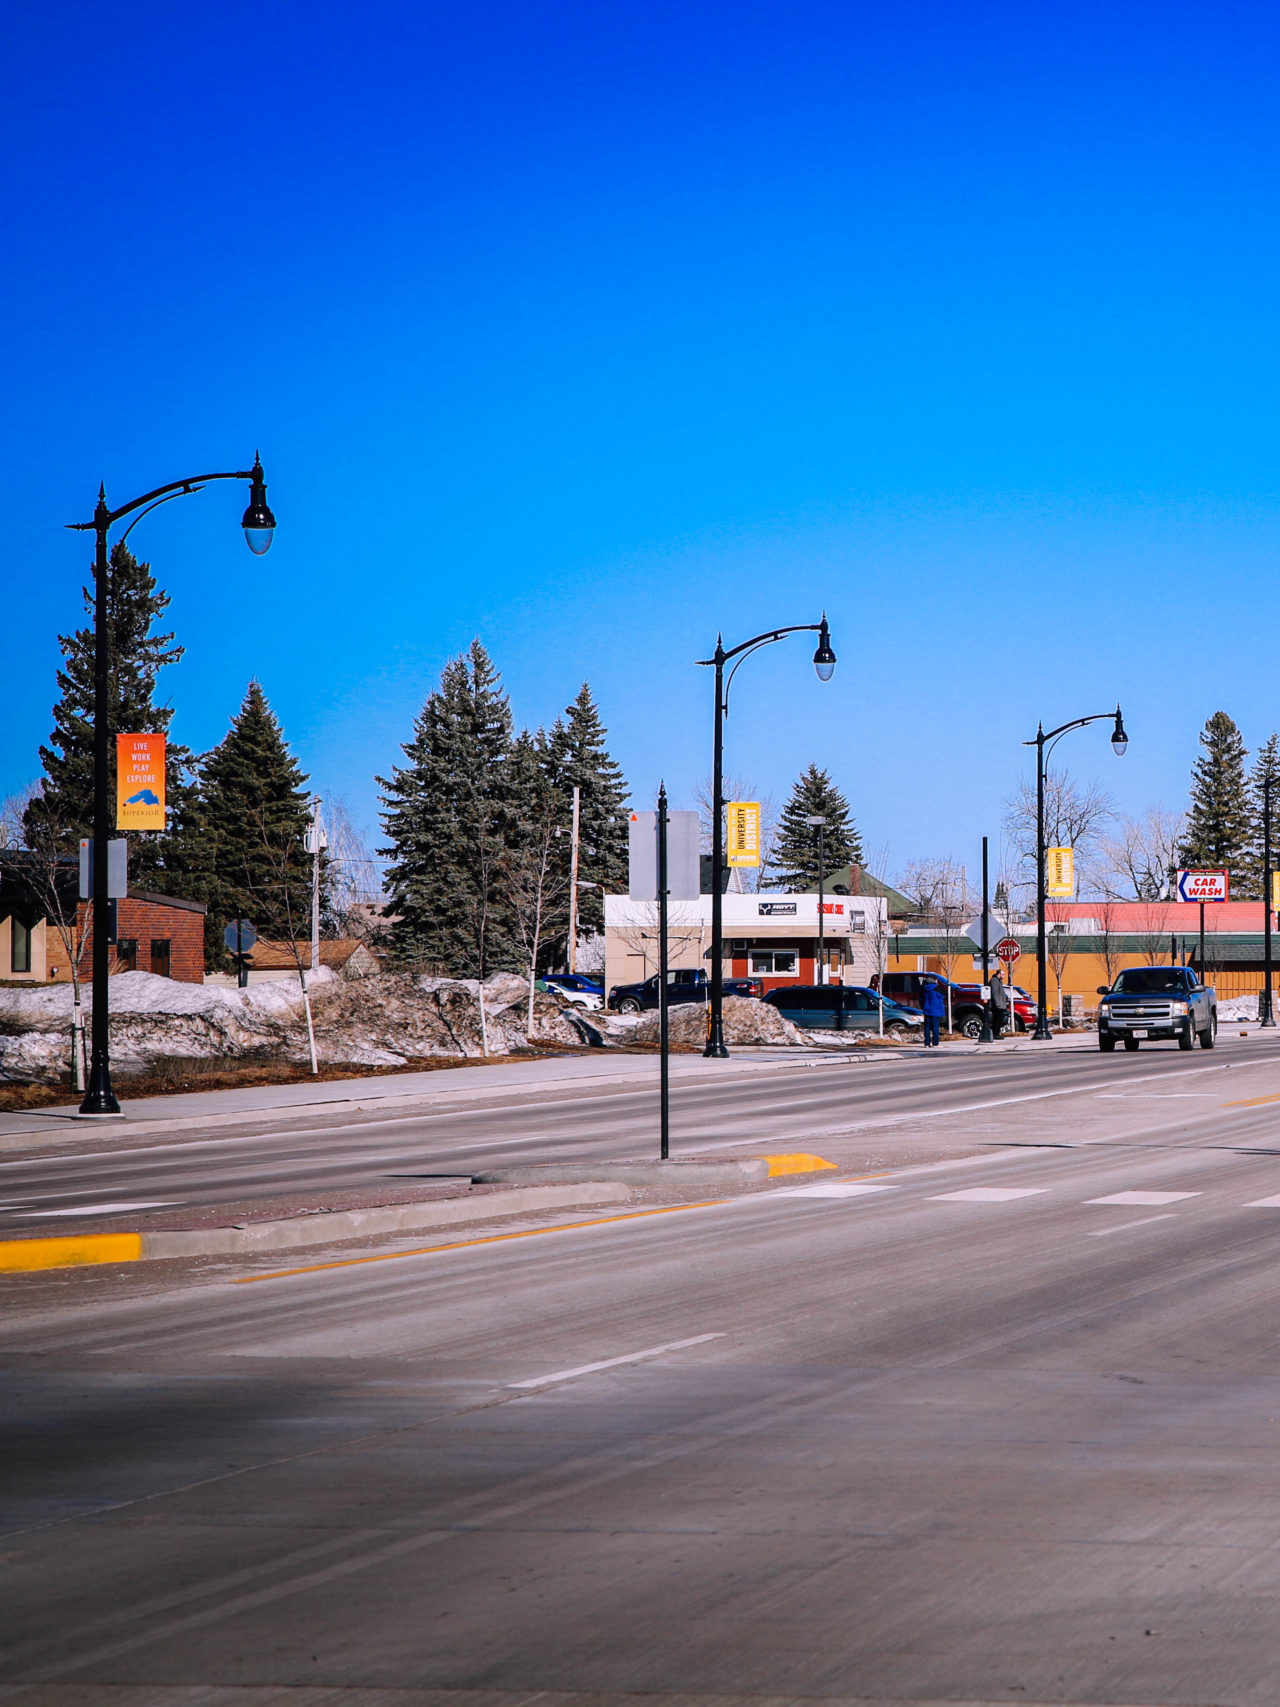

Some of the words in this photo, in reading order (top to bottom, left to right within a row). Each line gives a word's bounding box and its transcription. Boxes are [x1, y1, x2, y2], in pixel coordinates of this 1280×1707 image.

[133, 742, 148, 751] LIVE
[131, 753, 151, 761] WORK
[133, 764, 149, 772] PLAY
[126, 774, 156, 783] EXPLORE
[737, 808, 746, 850] UNIVERSITY
[746, 808, 757, 850] DISTRICT
[1194, 877, 1217, 887] CAR
[1188, 887, 1223, 896] WASH
[998, 947, 1019, 956] STOP
